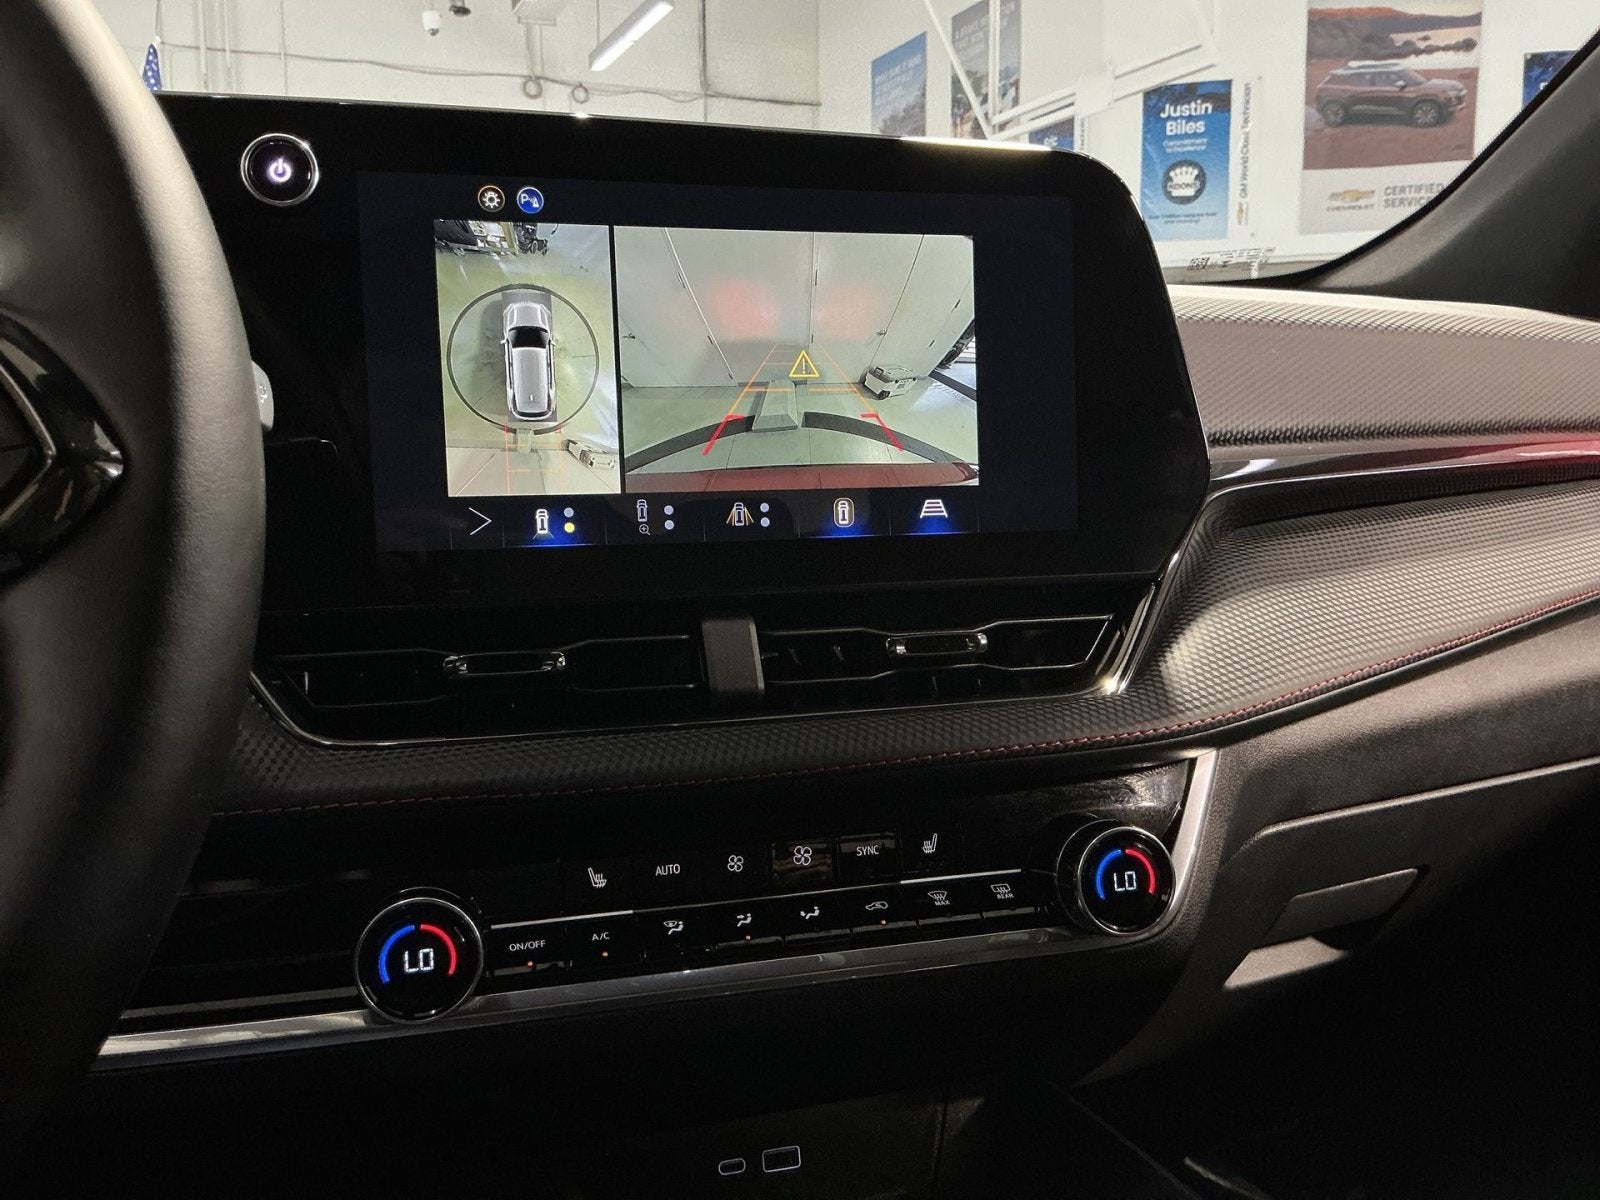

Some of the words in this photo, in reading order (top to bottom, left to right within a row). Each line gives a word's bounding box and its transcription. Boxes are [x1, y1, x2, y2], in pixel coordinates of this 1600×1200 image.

[1160, 99, 1212, 118] Justin
[1241, 83, 1252, 129] Technician
[1166, 119, 1206, 136] Biles
[1239, 156, 1249, 181] World
[1239, 182, 1249, 199] GM
[1384, 183, 1444, 196] CERTIFIED
[856, 844, 880, 857] SYNC
[655, 863, 681, 877] AUTO
[1113, 870, 1137, 892] LO
[591, 930, 610, 942] A/C
[508, 938, 547, 952] ON/OFF
[403, 947, 435, 973] LO
